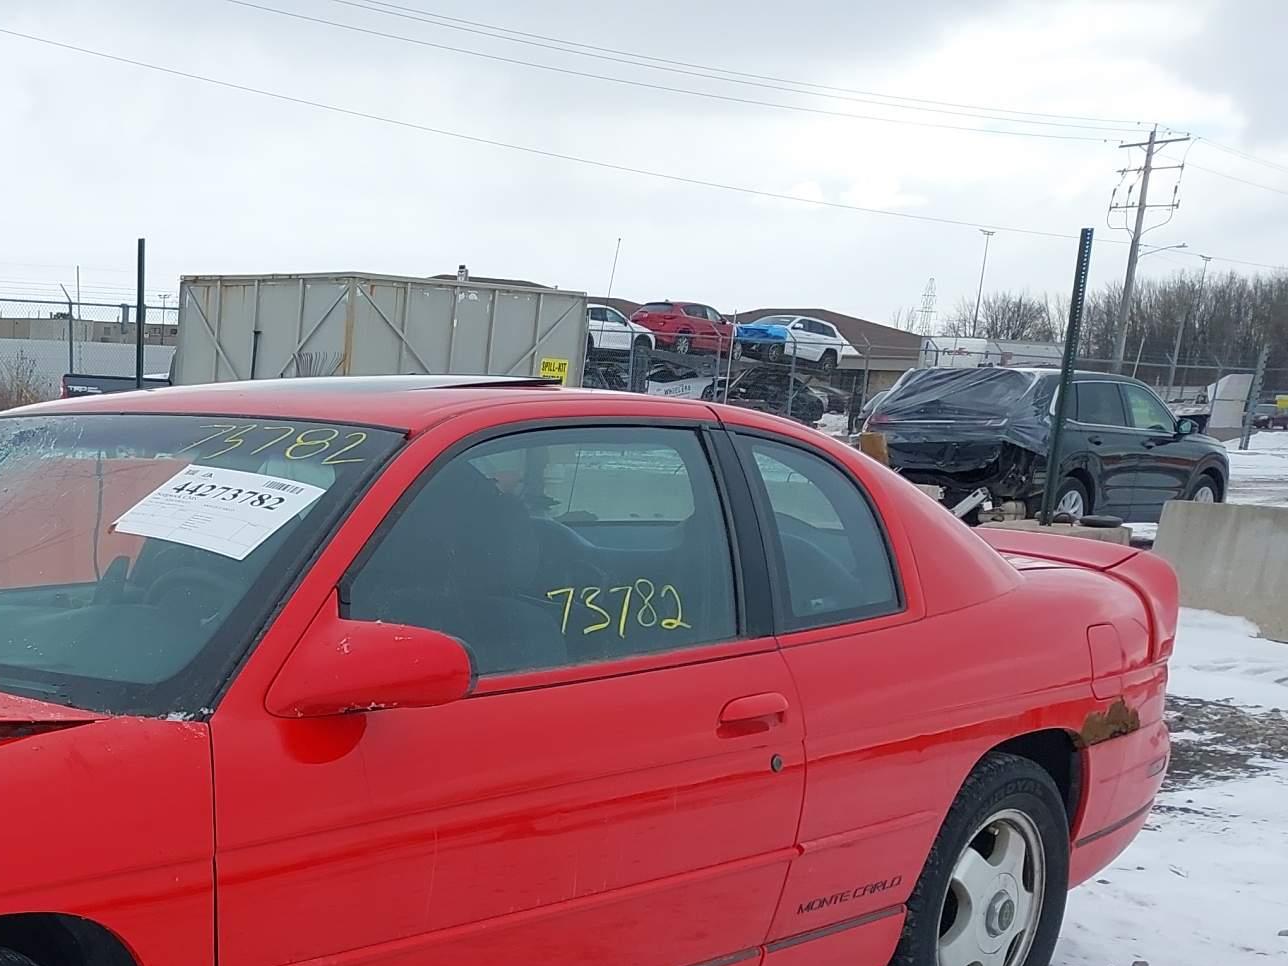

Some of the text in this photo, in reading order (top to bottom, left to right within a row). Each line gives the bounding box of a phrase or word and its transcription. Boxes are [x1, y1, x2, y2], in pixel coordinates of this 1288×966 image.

[542, 361, 567, 372] SPILL-KIT
[176, 423, 367, 465] 73782
[172, 480, 286, 511] 44273782
[545, 578, 692, 638] 73782
[796, 875, 903, 915] MONTE CARLO
